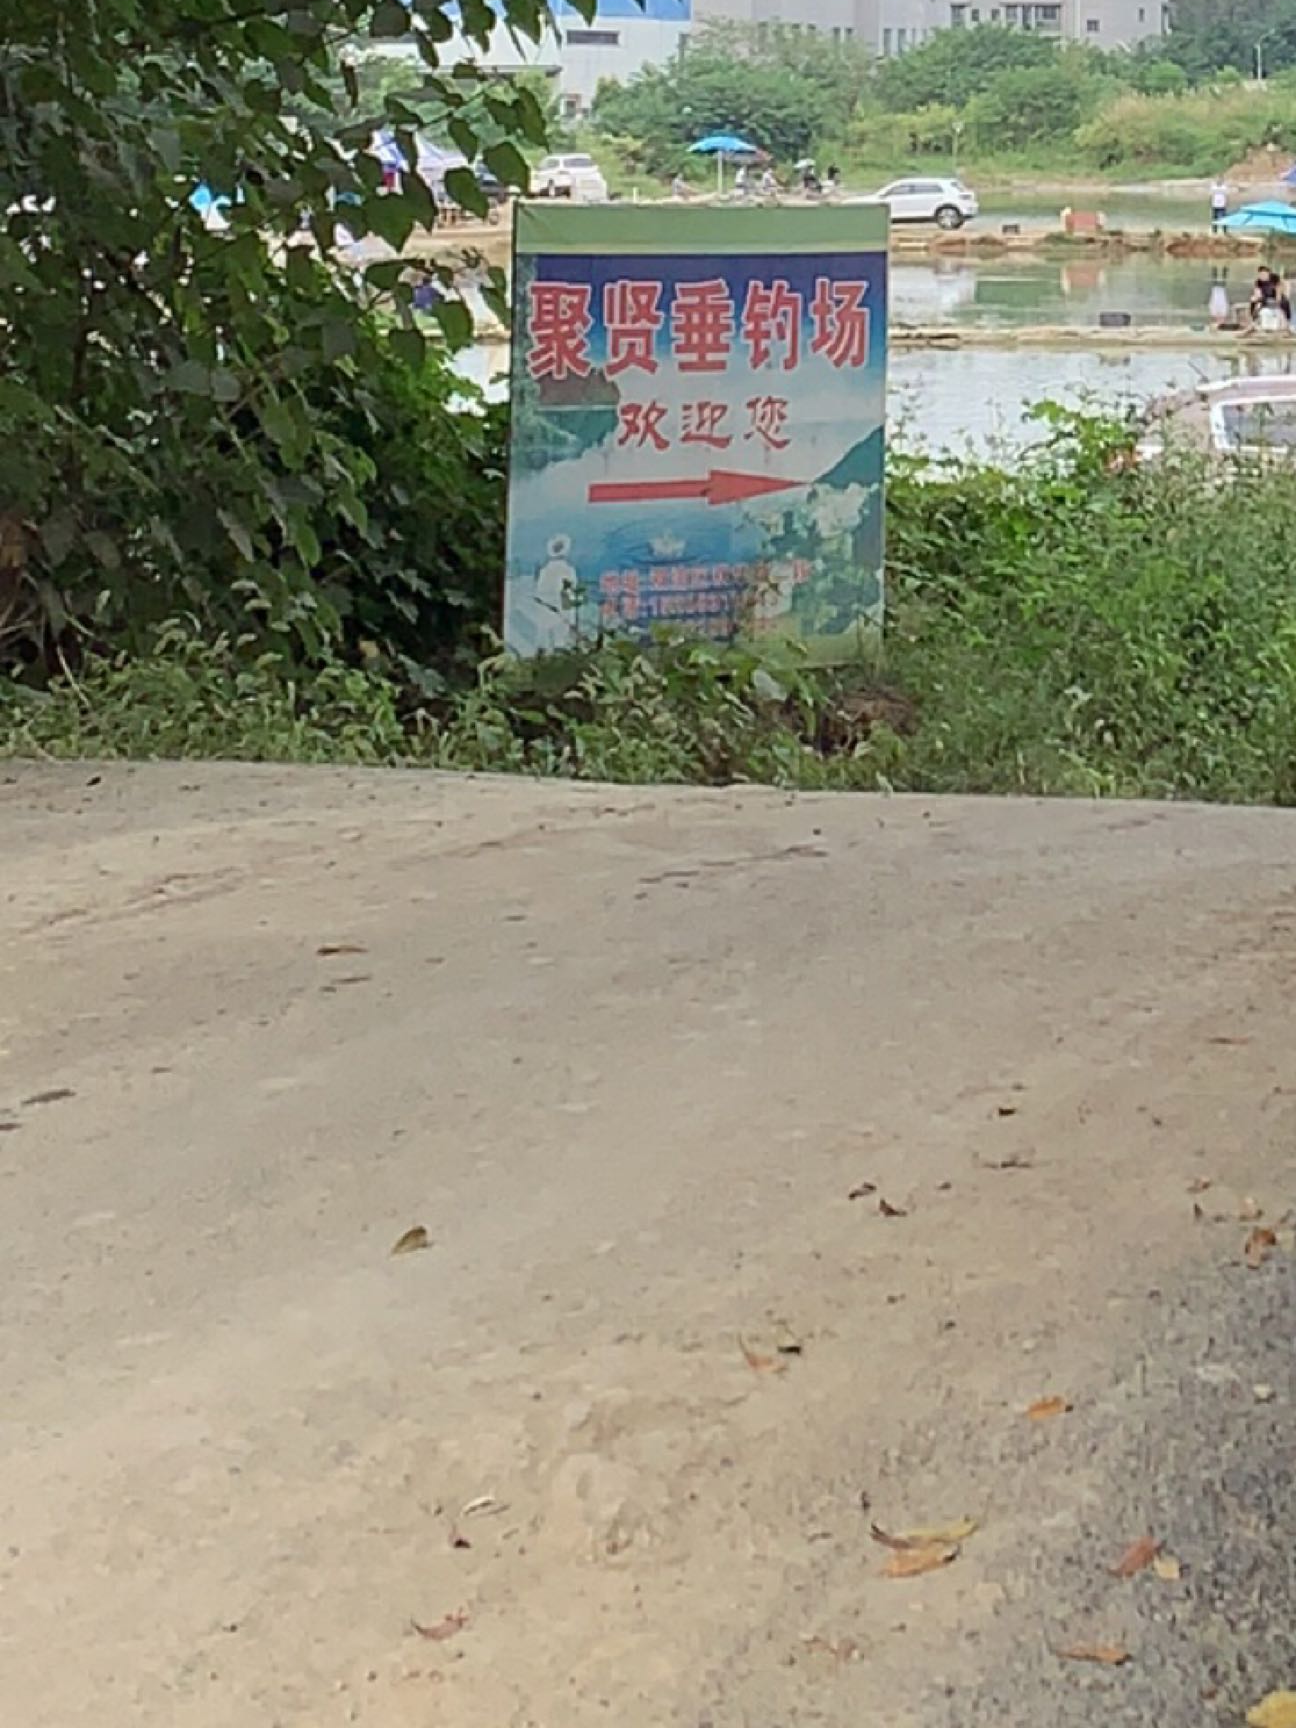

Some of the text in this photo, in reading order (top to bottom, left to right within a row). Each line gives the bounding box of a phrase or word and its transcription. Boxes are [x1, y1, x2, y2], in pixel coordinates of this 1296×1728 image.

[528, 279, 869, 380] 聚贤垂钓场
[618, 396, 792, 450] 欢迎您
